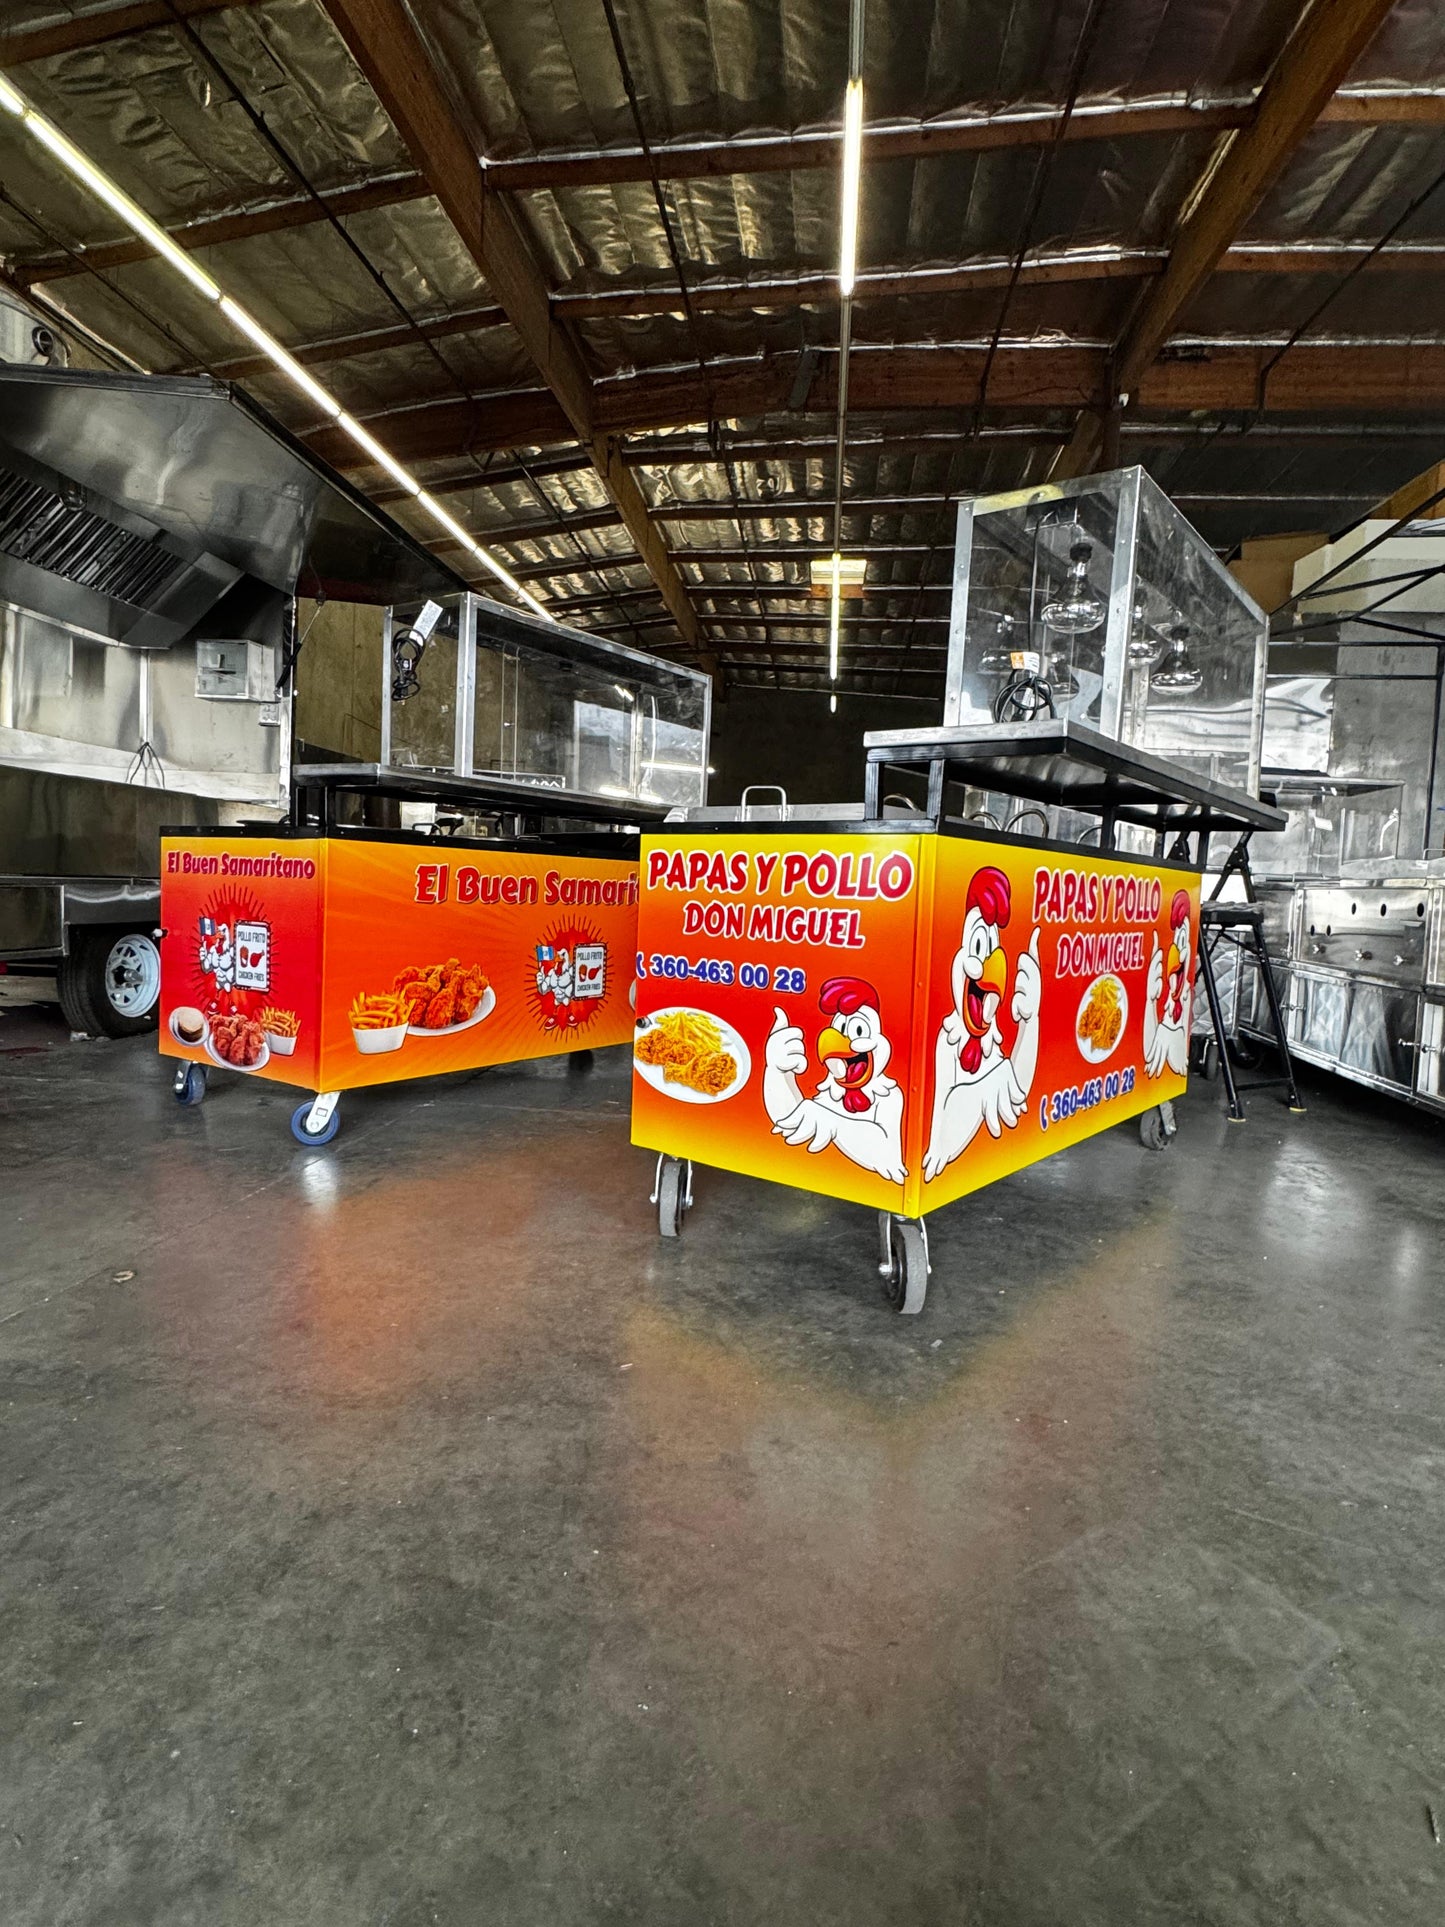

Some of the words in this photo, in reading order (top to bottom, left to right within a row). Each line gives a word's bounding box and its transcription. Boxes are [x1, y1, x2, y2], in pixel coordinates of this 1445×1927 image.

[168, 852, 180, 873] El
[182, 852, 218, 874] Buen
[221, 853, 315, 879] Samaritano
[416, 864, 449, 903] El
[456, 867, 538, 904] Buen
[648, 849, 748, 894] PAPAS
[755, 853, 778, 896] Y
[781, 850, 914, 901] POLLO
[1032, 866, 1099, 924] PAPAS
[1100, 874, 1114, 924] Y
[1113, 874, 1162, 924] POLLO
[683, 900, 744, 939] DON
[748, 904, 865, 948] MIGUEL
[650, 954, 734, 984] 360-463
[740, 964, 769, 988] 00
[774, 967, 806, 993] 28
[1055, 931, 1096, 979] DON
[1095, 932, 1144, 974] MIGUEL
[1050, 1076, 1102, 1123] 360-463
[1104, 1070, 1120, 1102] 00
[1120, 1065, 1136, 1095] 28
